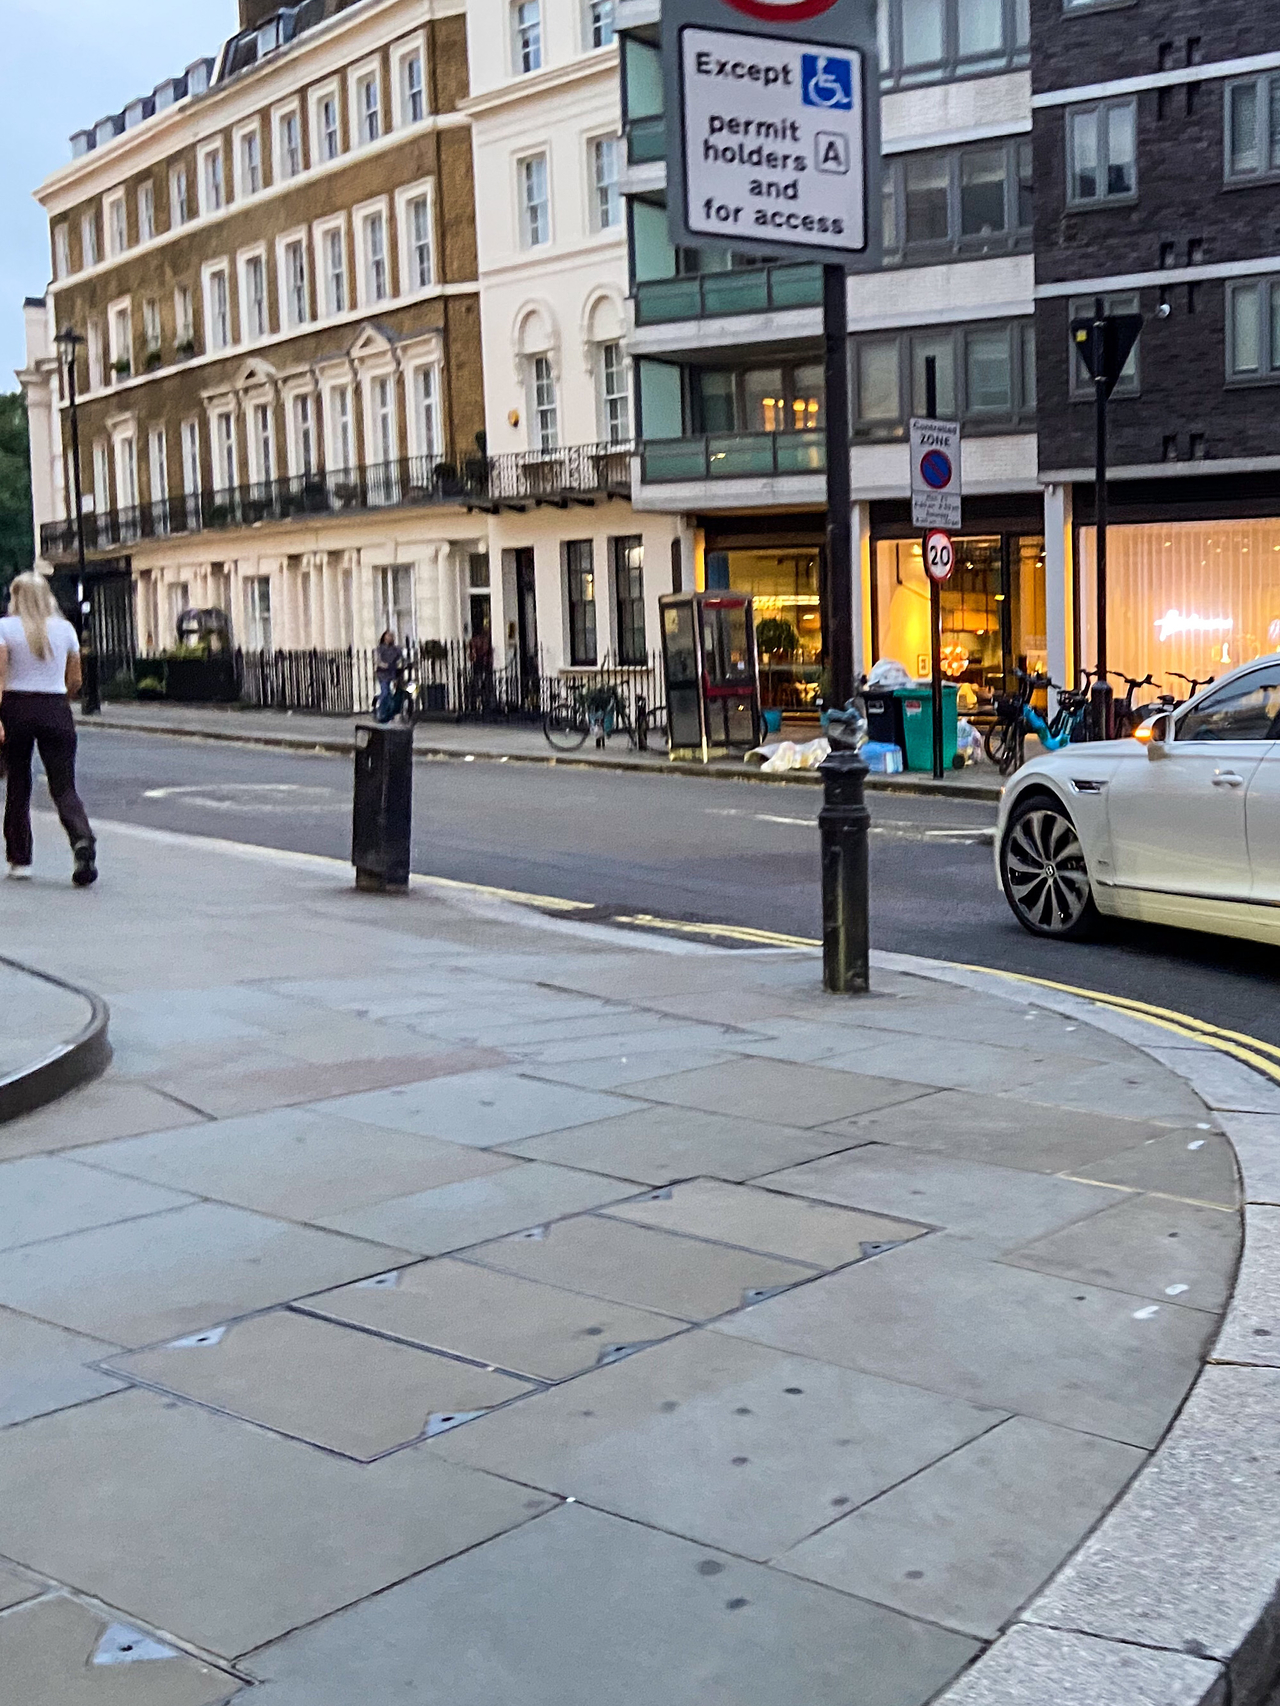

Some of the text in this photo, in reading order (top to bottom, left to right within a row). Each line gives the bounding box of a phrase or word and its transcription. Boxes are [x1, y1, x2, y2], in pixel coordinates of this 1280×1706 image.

[696, 51, 793, 87] Except
[708, 114, 801, 142] permit
[703, 138, 808, 172] holders
[822, 140, 844, 167] A
[749, 178, 799, 200] and
[703, 197, 845, 235] for access
[920, 433, 951, 447] ZONE
[930, 545, 950, 566] 20
